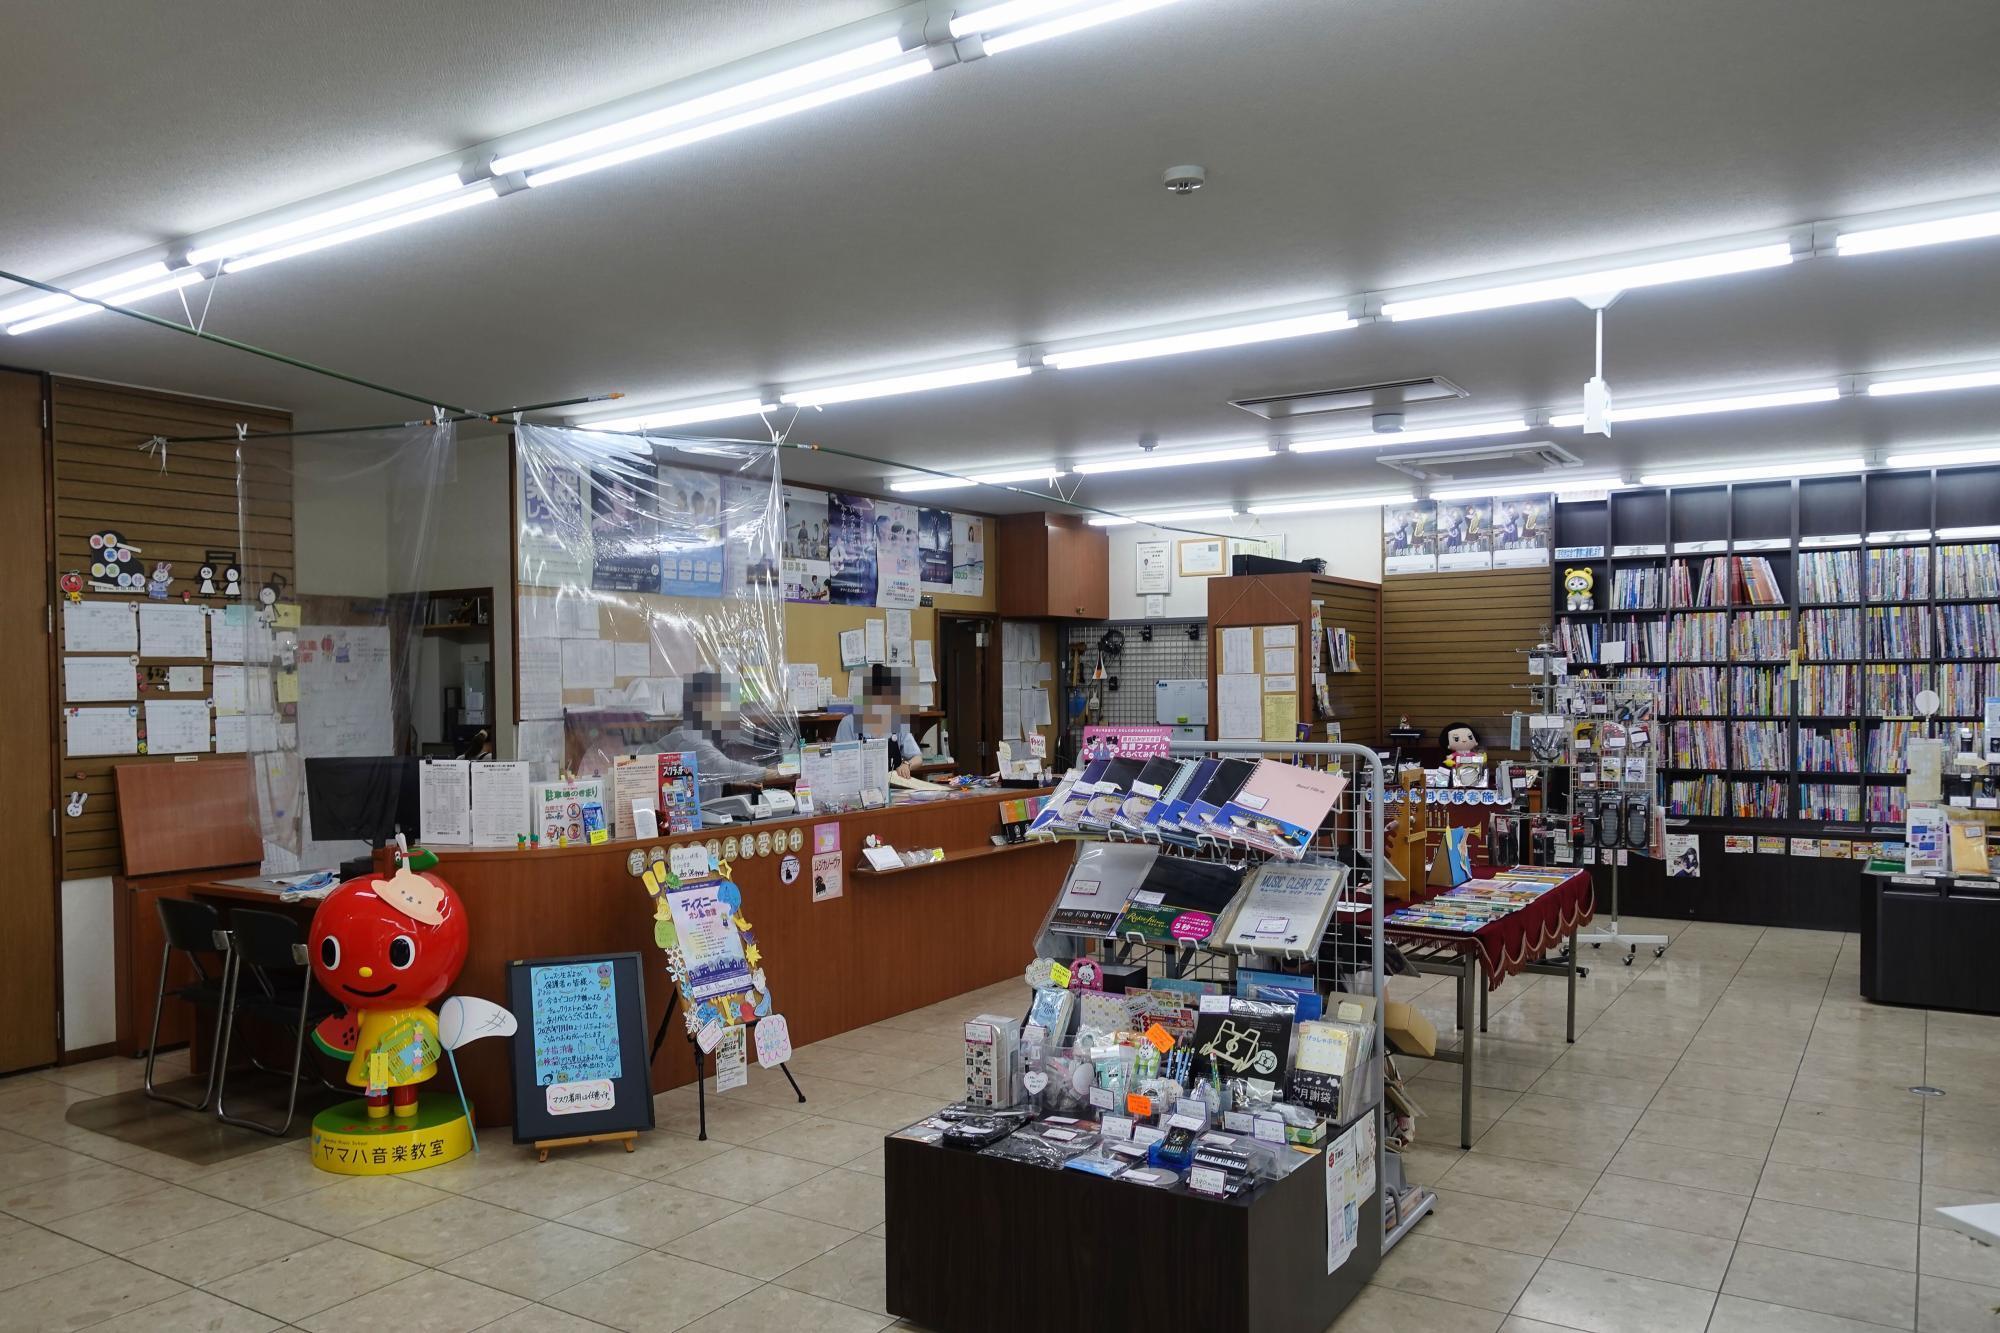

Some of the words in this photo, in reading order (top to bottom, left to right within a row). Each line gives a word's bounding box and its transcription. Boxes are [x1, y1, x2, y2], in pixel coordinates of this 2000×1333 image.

[1121, 743, 1167, 751] 楽譜ファイル
[1260, 874, 1287, 888] MUSIC
[1286, 876, 1312, 890] CLEAR
[1313, 878, 1331, 891] FILE
[682, 896, 718, 912] ディズニー
[1300, 1088, 1331, 1104] 月謝袋
[323, 1139, 444, 1164] ヤマハ音楽教室
